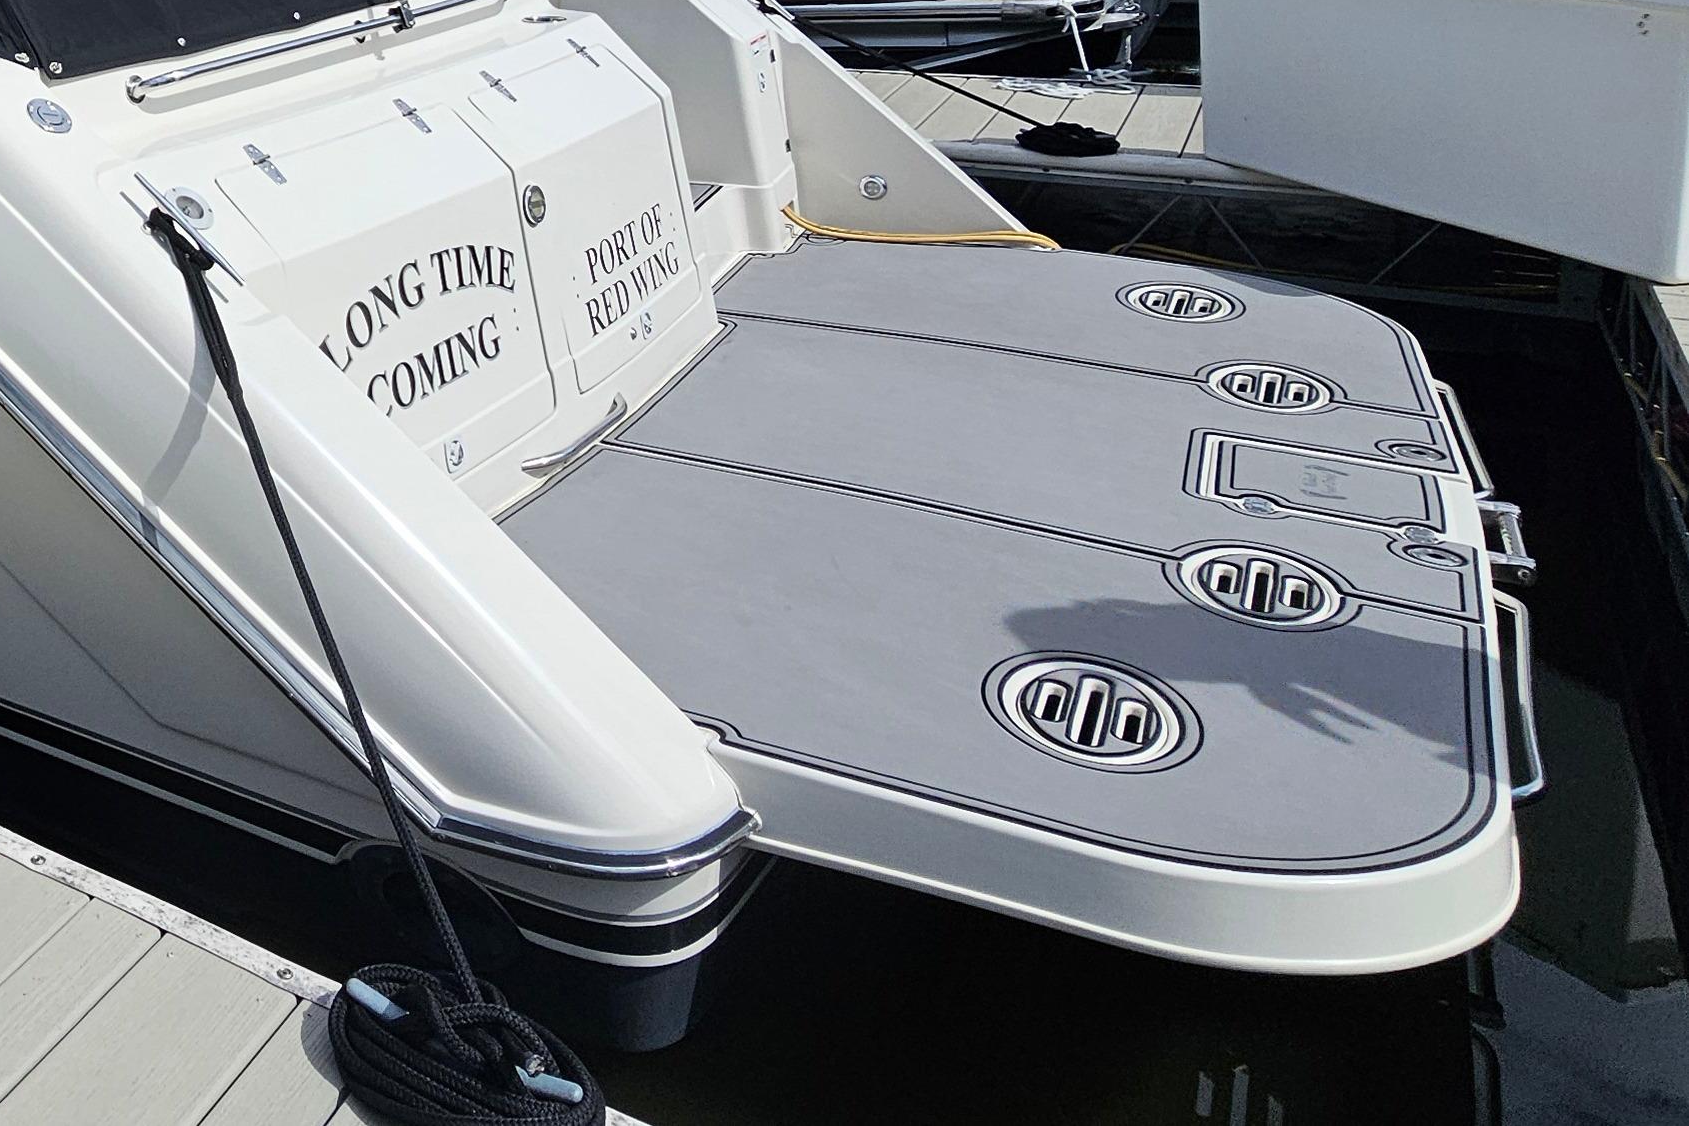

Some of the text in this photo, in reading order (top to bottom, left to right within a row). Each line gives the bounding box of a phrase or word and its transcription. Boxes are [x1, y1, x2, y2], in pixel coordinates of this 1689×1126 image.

[584, 203, 662, 285] PORT OF
[584, 241, 679, 338] RED WING
[318, 244, 516, 372] LONG TIME
[367, 313, 501, 418] COMING
